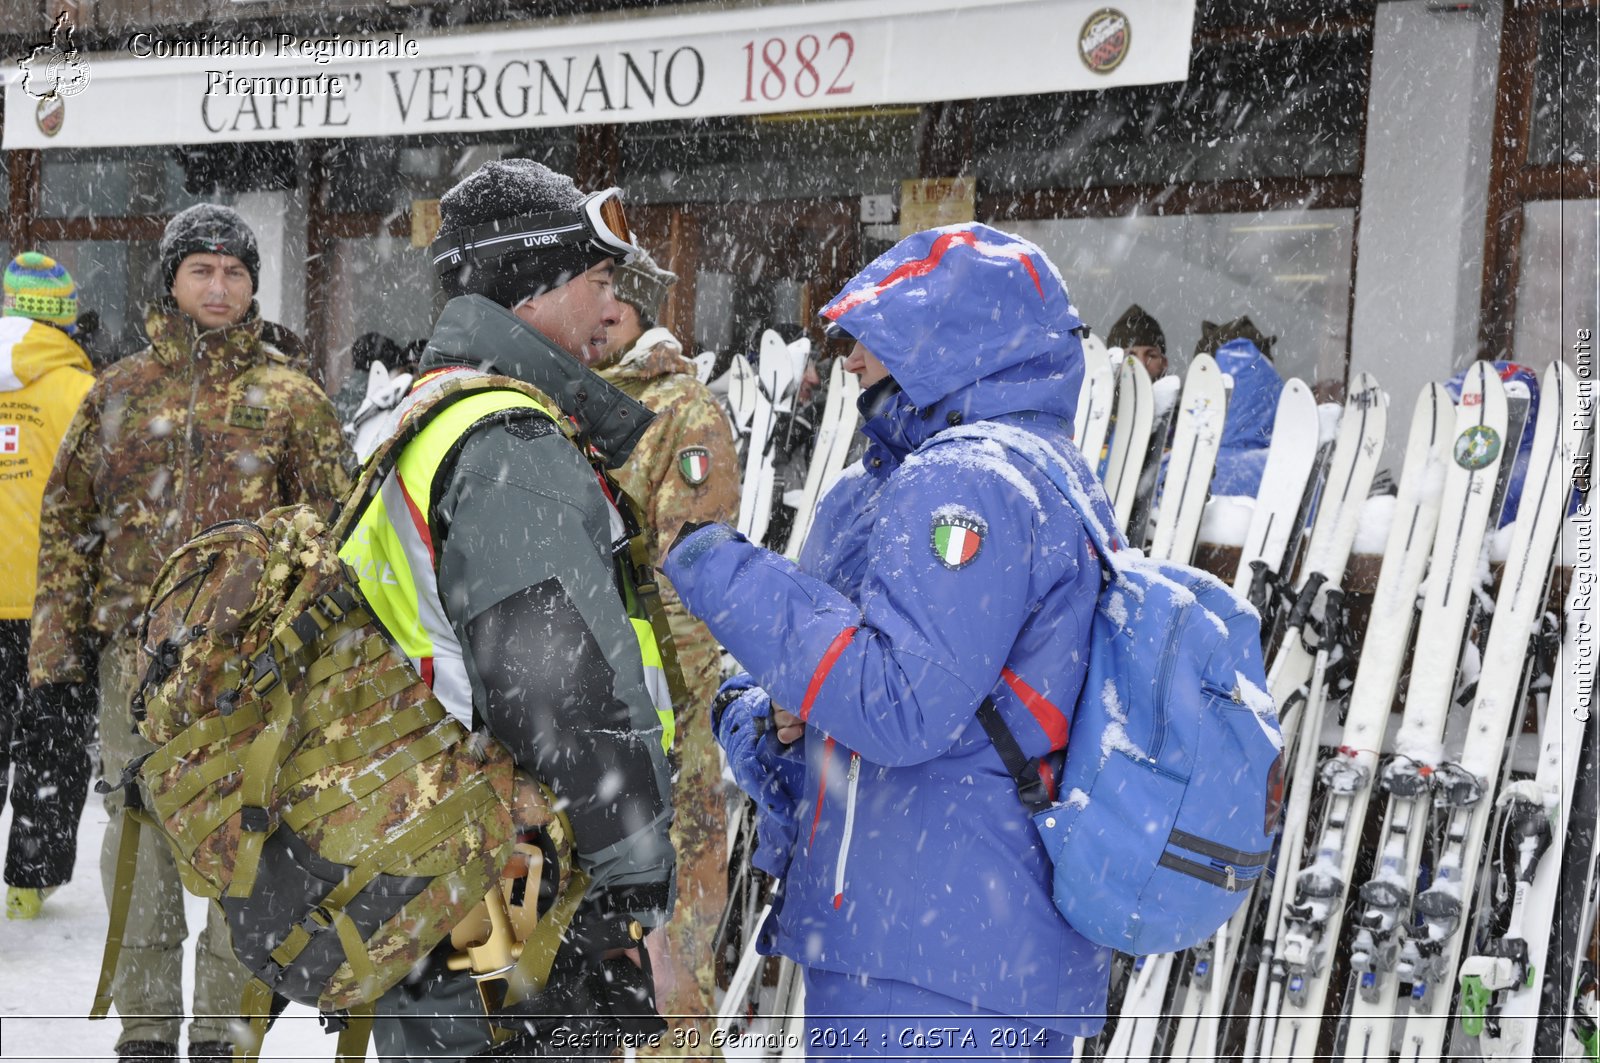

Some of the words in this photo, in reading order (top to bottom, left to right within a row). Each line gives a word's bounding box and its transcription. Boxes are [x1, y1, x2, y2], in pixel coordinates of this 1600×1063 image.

[388, 46, 705, 124] VERGNANO
[740, 31, 855, 102] 1882
[523, 233, 559, 248] uvex
[941, 518, 979, 533] ITALIA
